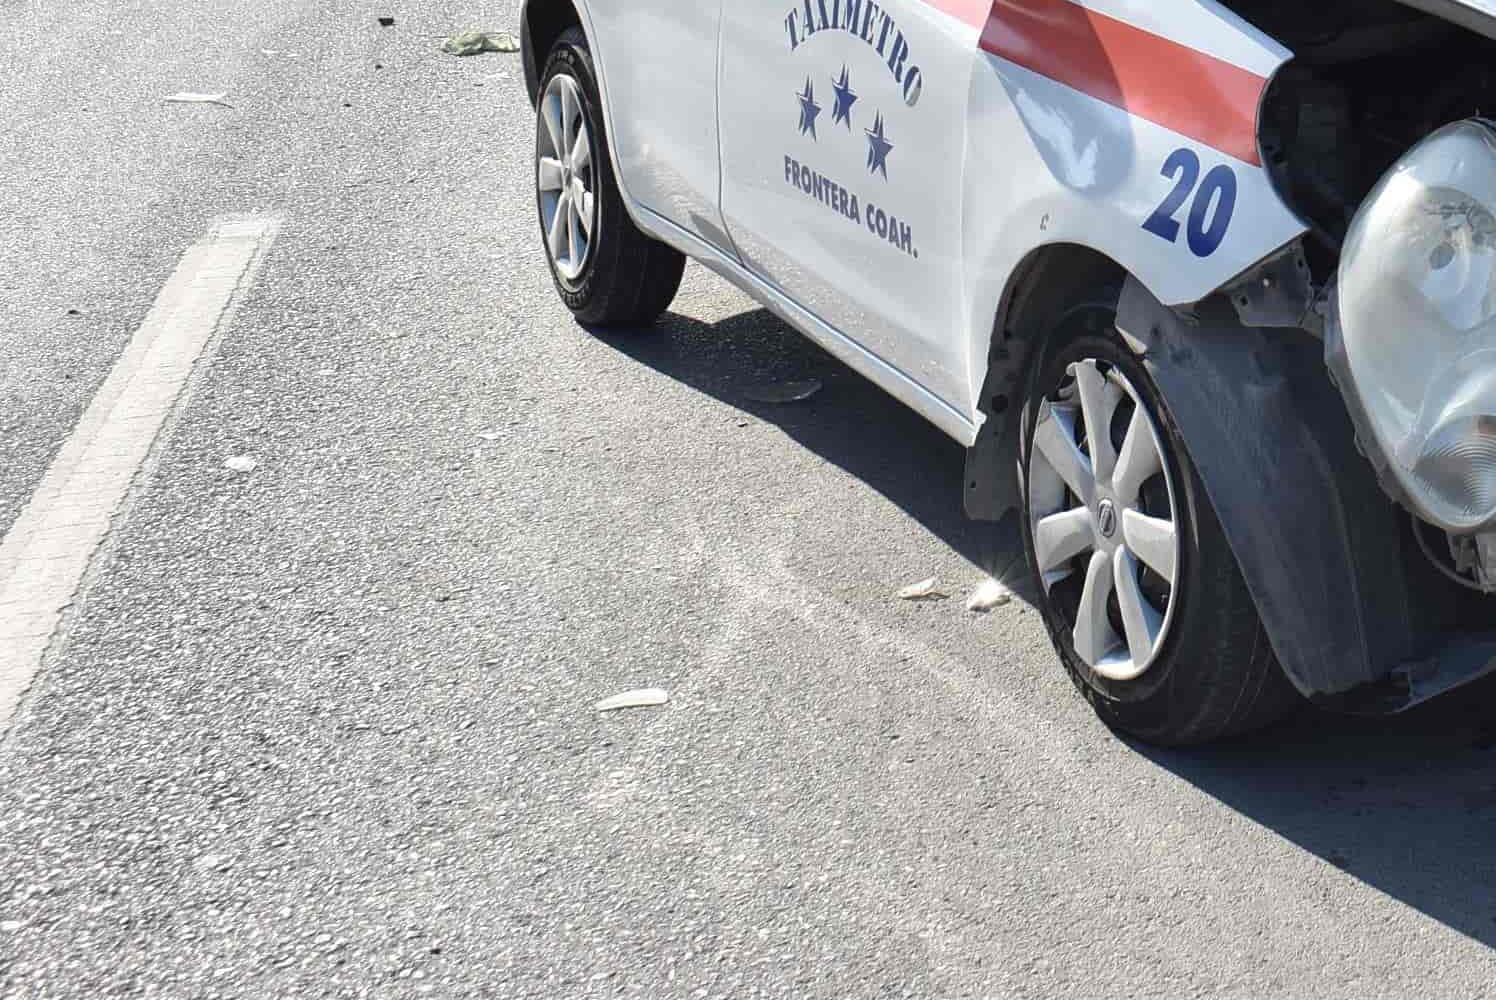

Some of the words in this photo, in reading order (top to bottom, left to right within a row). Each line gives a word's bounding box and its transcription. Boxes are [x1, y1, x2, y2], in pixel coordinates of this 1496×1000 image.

[784, 154, 861, 225] FRONTERA
[865, 202, 918, 259] COAH.
[1140, 147, 1238, 258] 20
